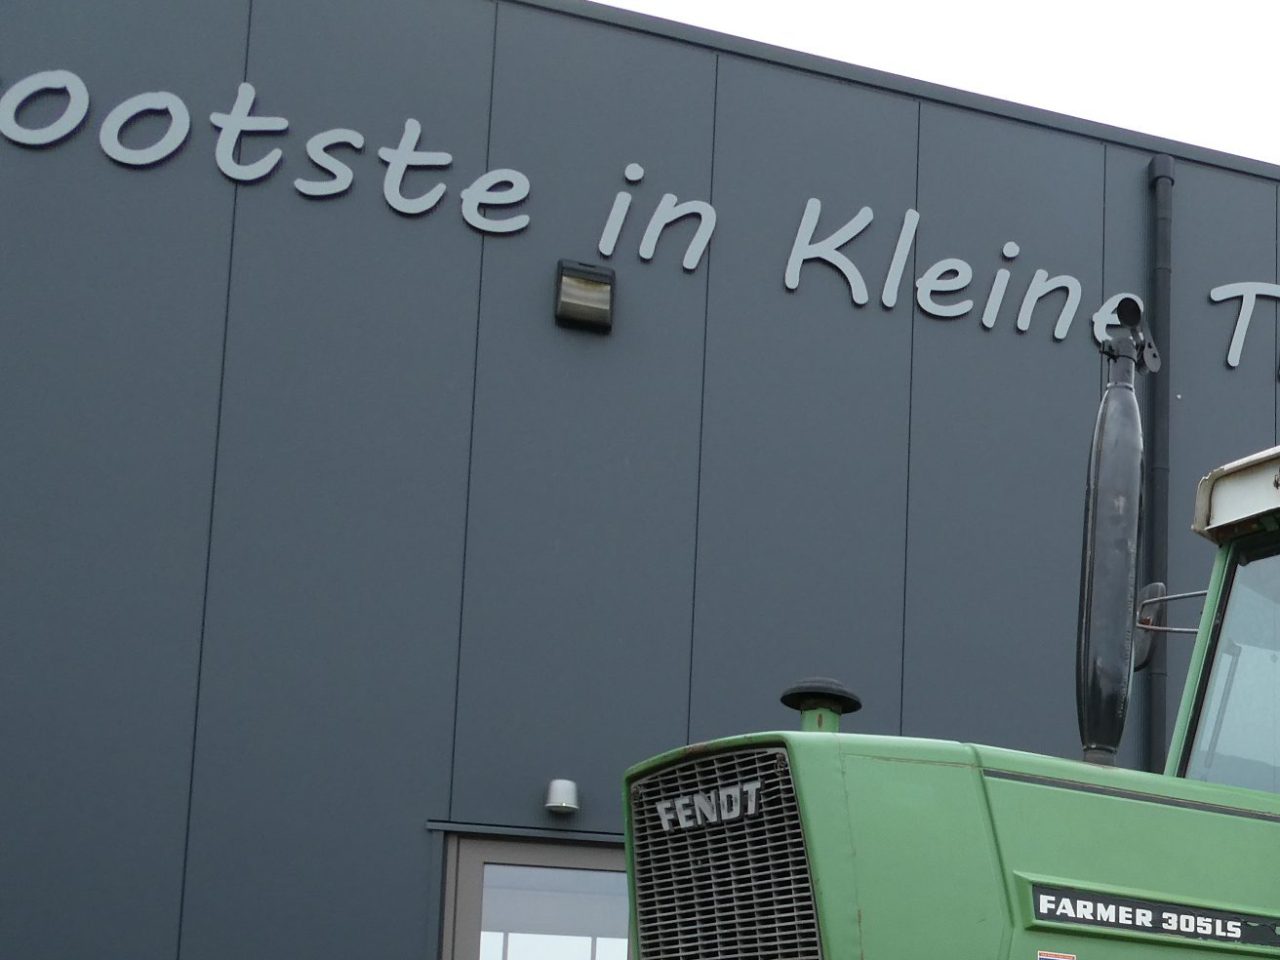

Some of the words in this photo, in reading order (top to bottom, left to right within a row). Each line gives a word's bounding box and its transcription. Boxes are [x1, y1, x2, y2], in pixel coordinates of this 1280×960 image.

[598, 163, 717, 271] in
[783, 198, 1145, 342] Kleine
[655, 779, 764, 832] FENDT
[1038, 894, 1153, 928] FARMER
